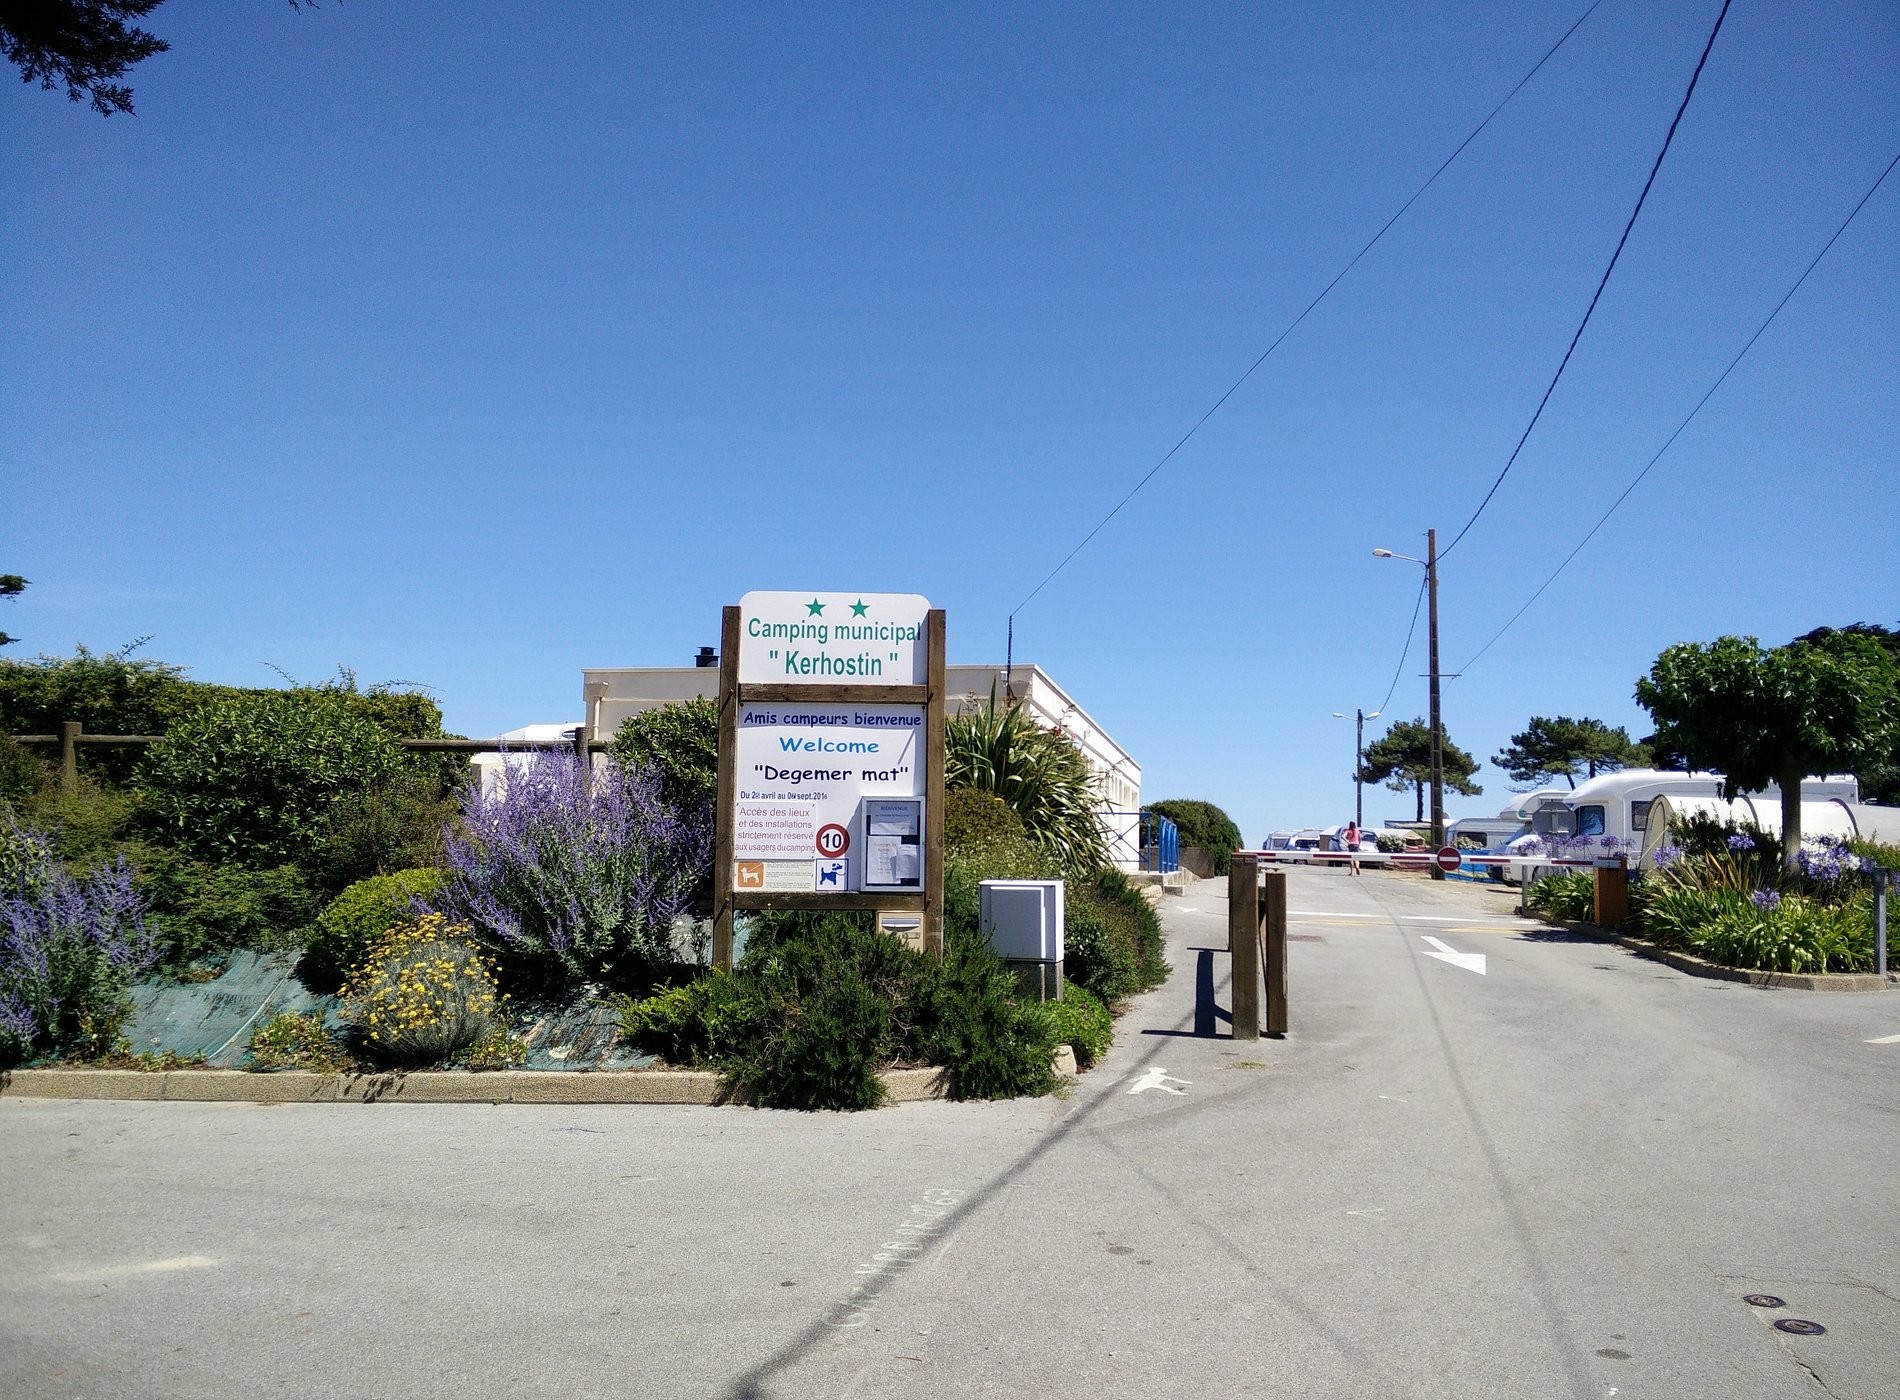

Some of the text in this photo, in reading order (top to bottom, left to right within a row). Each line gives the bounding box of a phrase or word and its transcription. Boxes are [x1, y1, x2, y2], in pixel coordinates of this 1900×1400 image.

[748, 618, 921, 646] Camping municipal
[785, 650, 882, 676] Kerhostin
[744, 712, 921, 728] Amis campeurs bienvenue
[779, 737, 879, 754] Welcome
[754, 765, 909, 784] "Degemer mat"
[740, 791, 750, 799] Du
[761, 792, 776, 800] avril
[739, 807, 810, 817] Accès des lieux
[738, 820, 813, 829] et des installations
[737, 831, 814, 840] strictement réservé
[822, 833, 842, 849] 10
[748, 844, 776, 853] usagers
[786, 844, 816, 854] camping
